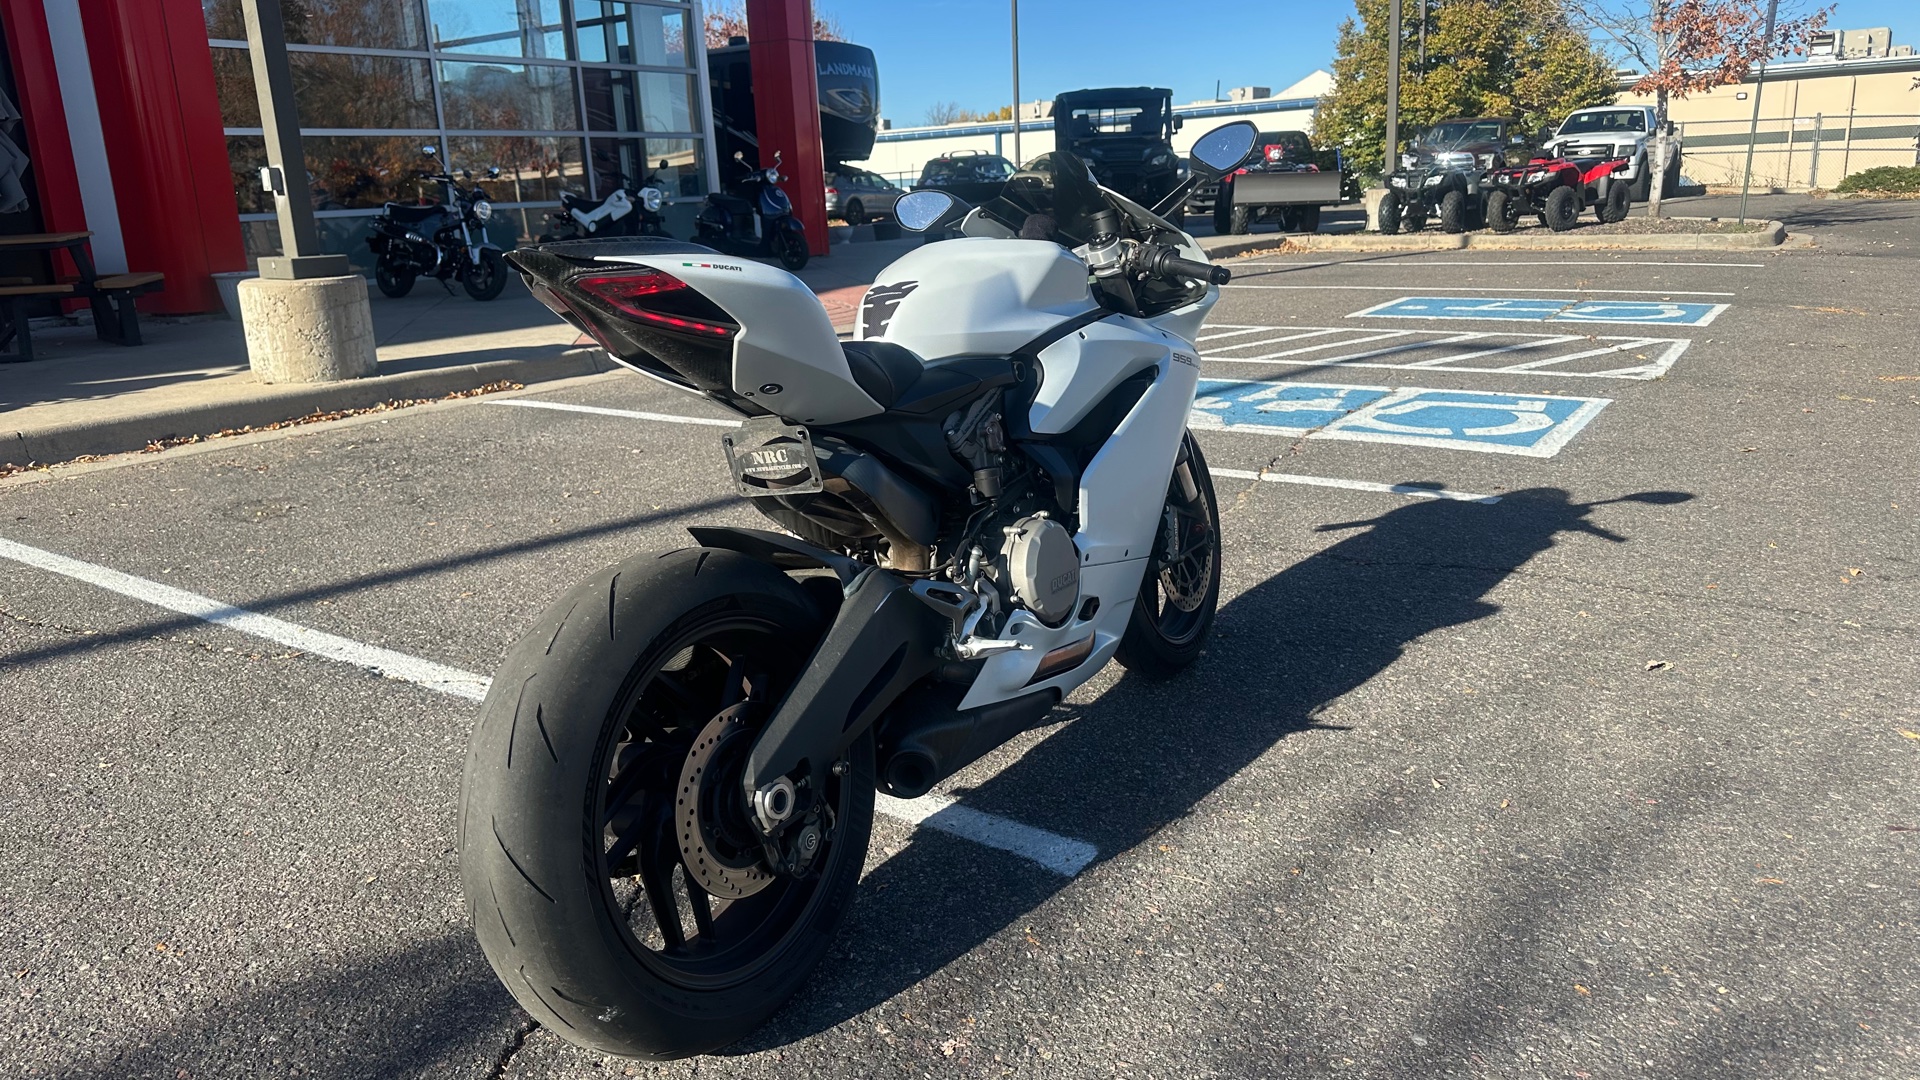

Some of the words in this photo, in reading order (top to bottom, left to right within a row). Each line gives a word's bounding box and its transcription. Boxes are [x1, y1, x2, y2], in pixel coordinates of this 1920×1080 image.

[817, 62, 874, 79] LANDMARK
[712, 264, 742, 272] DUCATI
[1172, 352, 1192, 367] 959
[751, 449, 788, 465] NRC
